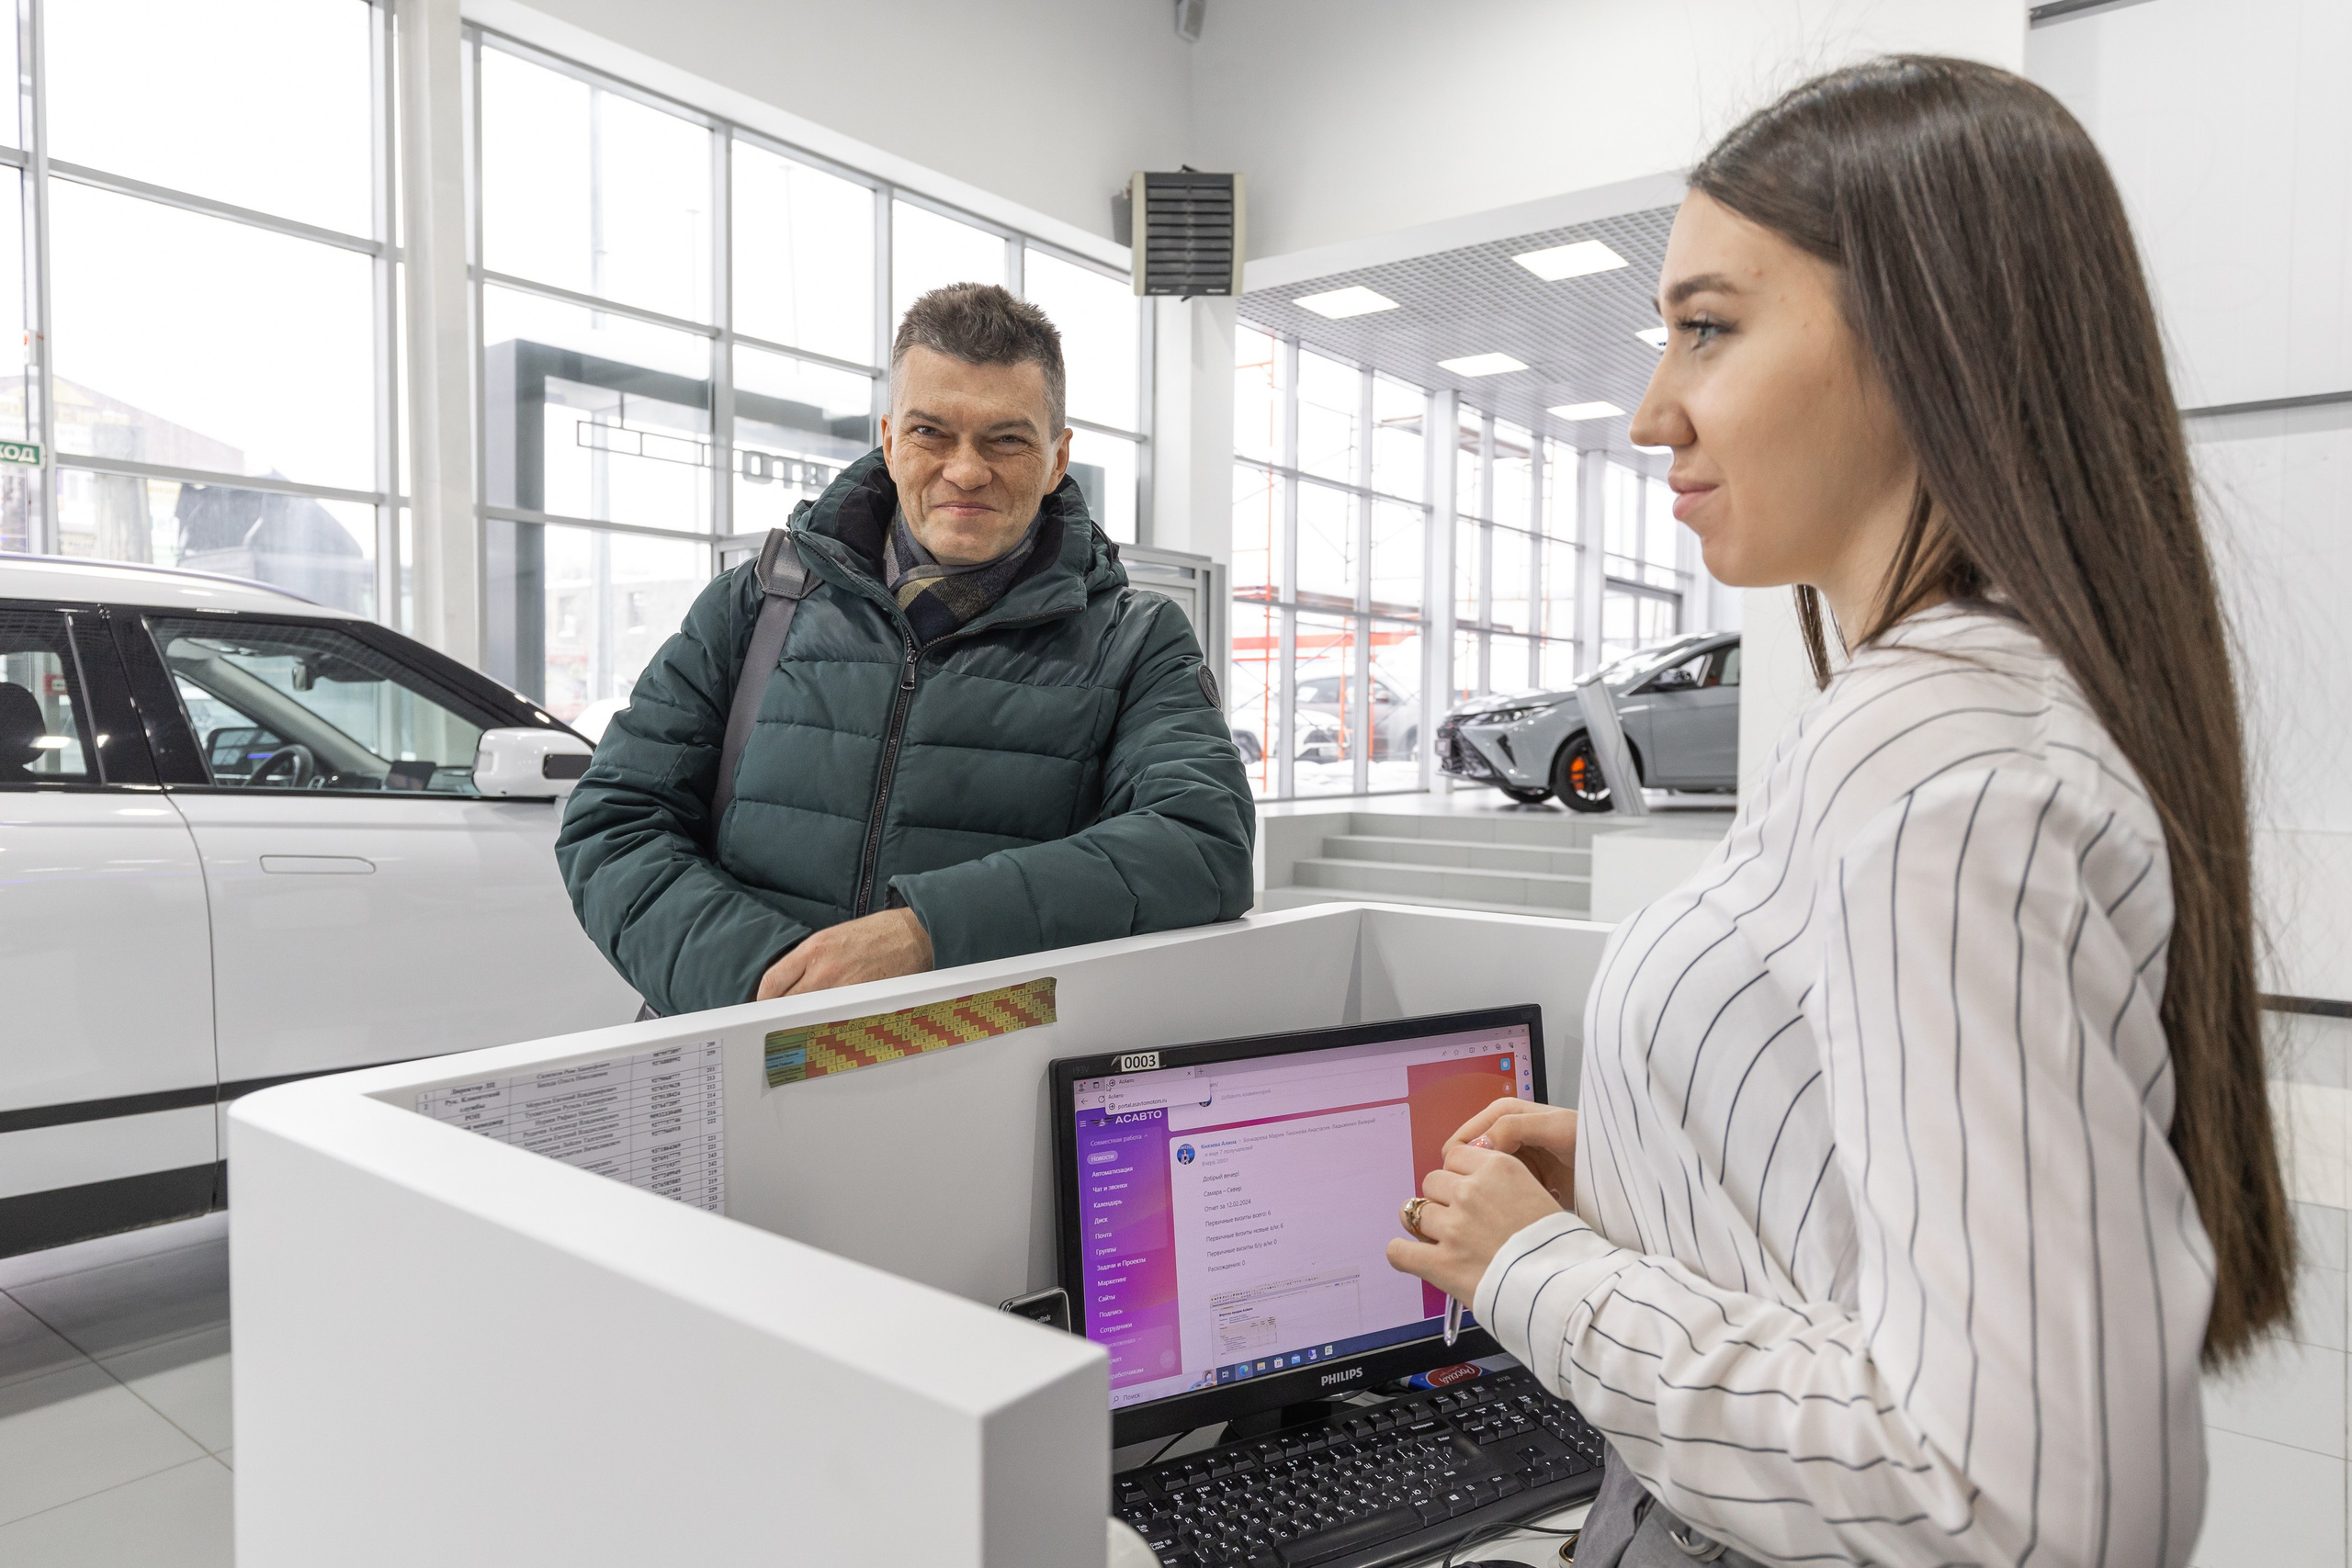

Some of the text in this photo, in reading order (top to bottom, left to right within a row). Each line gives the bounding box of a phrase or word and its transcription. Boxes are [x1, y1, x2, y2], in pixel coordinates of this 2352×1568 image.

[0, 446, 37, 463] ОД
[1125, 1055, 1156, 1068] 0003
[1114, 1111, 1162, 1124] АСАВТО
[1091, 1134, 1142, 1147] Совместная работа
[1091, 1155, 1114, 1163] Новости
[1091, 1167, 1134, 1178] Автоматизация
[1203, 1171, 1240, 1183] Добрый вечер!
[1108, 1182, 1128, 1190] звонки
[1204, 1189, 1222, 1197] Самара
[1093, 1200, 1123, 1209] Календарь
[1227, 1199, 1251, 1208] 12.02.2024
[1204, 1217, 1233, 1227] Первичные
[1234, 1214, 1252, 1223] визиты
[1206, 1233, 1235, 1243] Первичные
[1096, 1247, 1116, 1256] Группы
[1206, 1248, 1235, 1258] Первичные
[1097, 1263, 1116, 1271] Задачи
[1122, 1258, 1146, 1267] Проекты
[1208, 1263, 1240, 1272] Расхождения:
[1097, 1277, 1127, 1287] Маркетинг
[1098, 1294, 1115, 1303] Сайты
[1099, 1309, 1124, 1318] Подпись
[1030, 1314, 1051, 1324] alink
[1100, 1323, 1133, 1334] Сотрудники
[1321, 1367, 1363, 1386] PHILIPS
[1439, 1365, 1476, 1384] Россия
[1123, 1393, 1141, 1401] Поиск
[1410, 1422, 1434, 1430] Backspace
